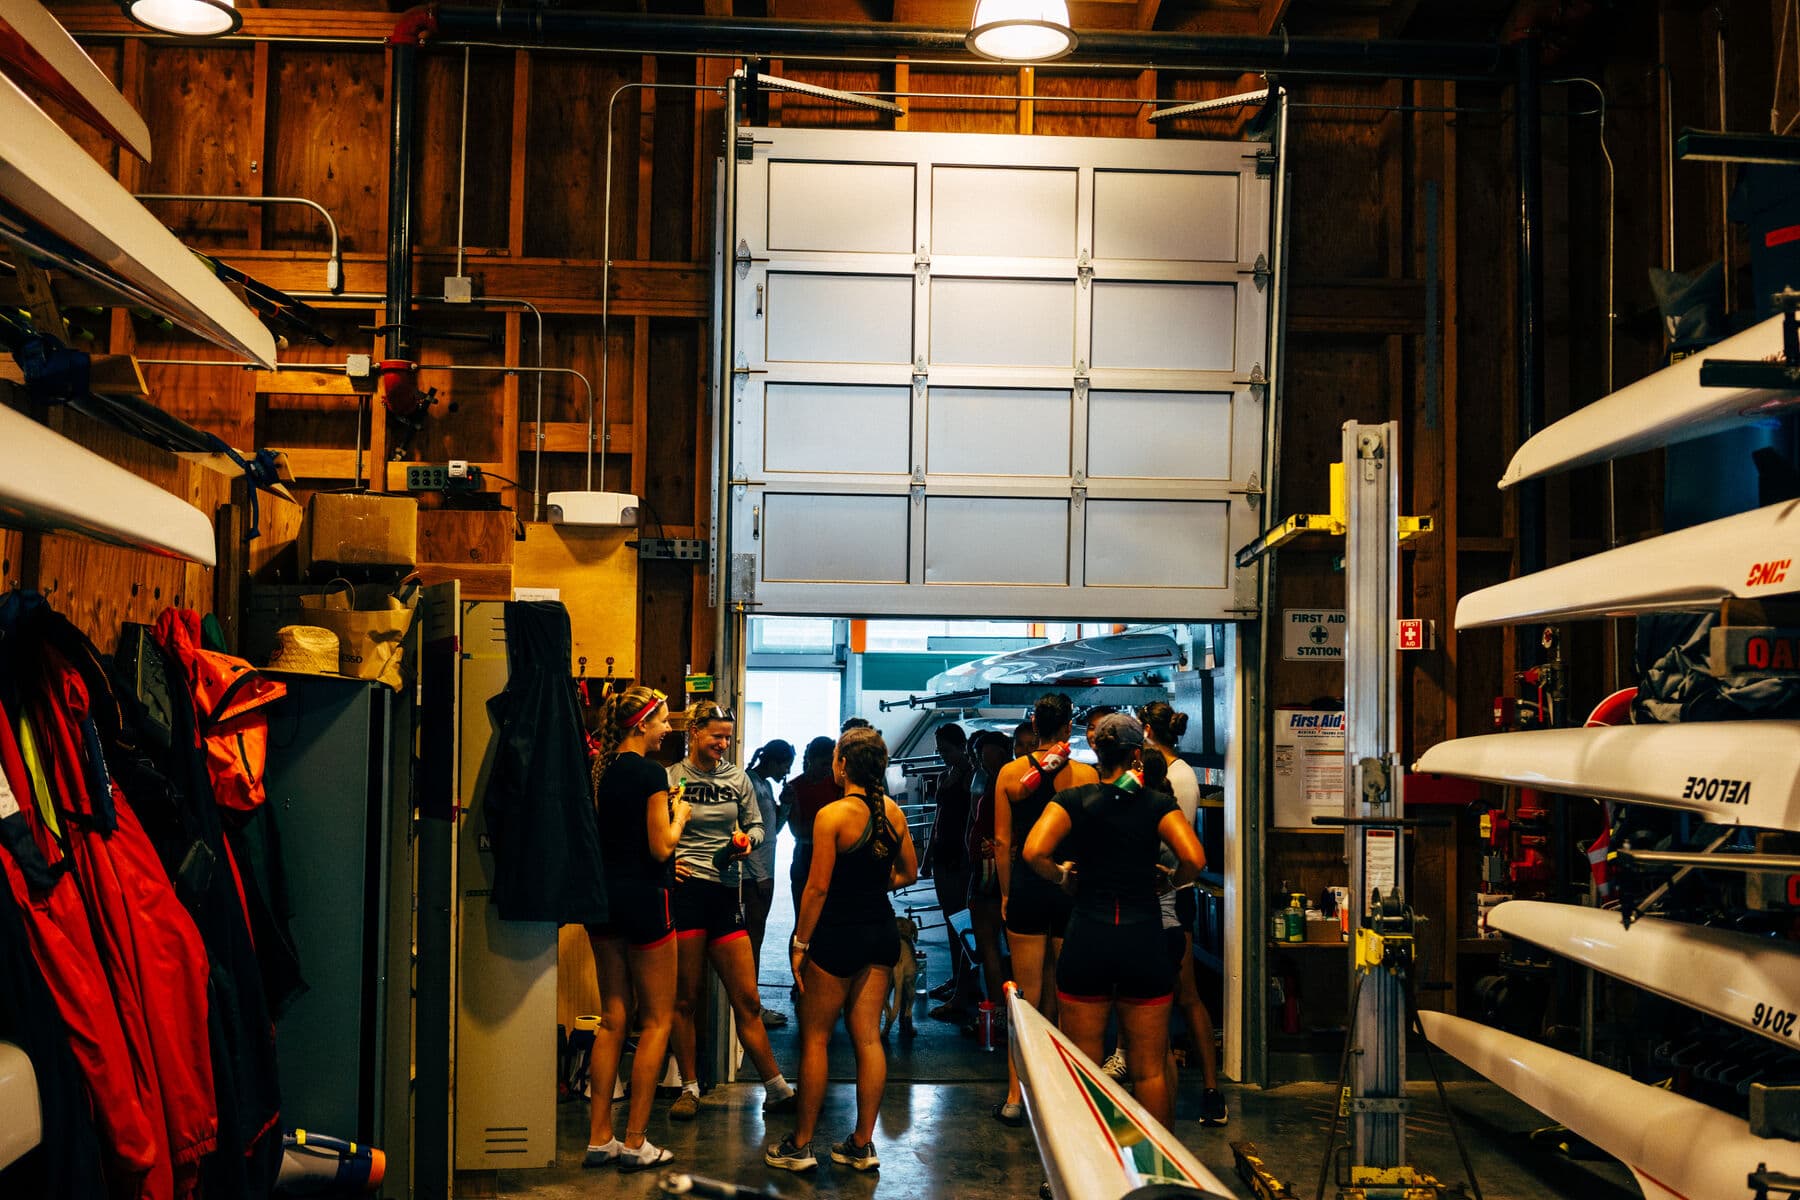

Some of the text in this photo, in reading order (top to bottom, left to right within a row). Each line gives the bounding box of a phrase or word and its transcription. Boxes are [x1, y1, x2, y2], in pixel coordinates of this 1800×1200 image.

[1292, 614, 1346, 623] FIRST AID
[1297, 647, 1341, 656] STATION
[1290, 714, 1319, 727] First
[1320, 714, 1342, 727] Aid
[1682, 776, 1751, 804] VELOCE
[1752, 1003, 1797, 1036] 2016
